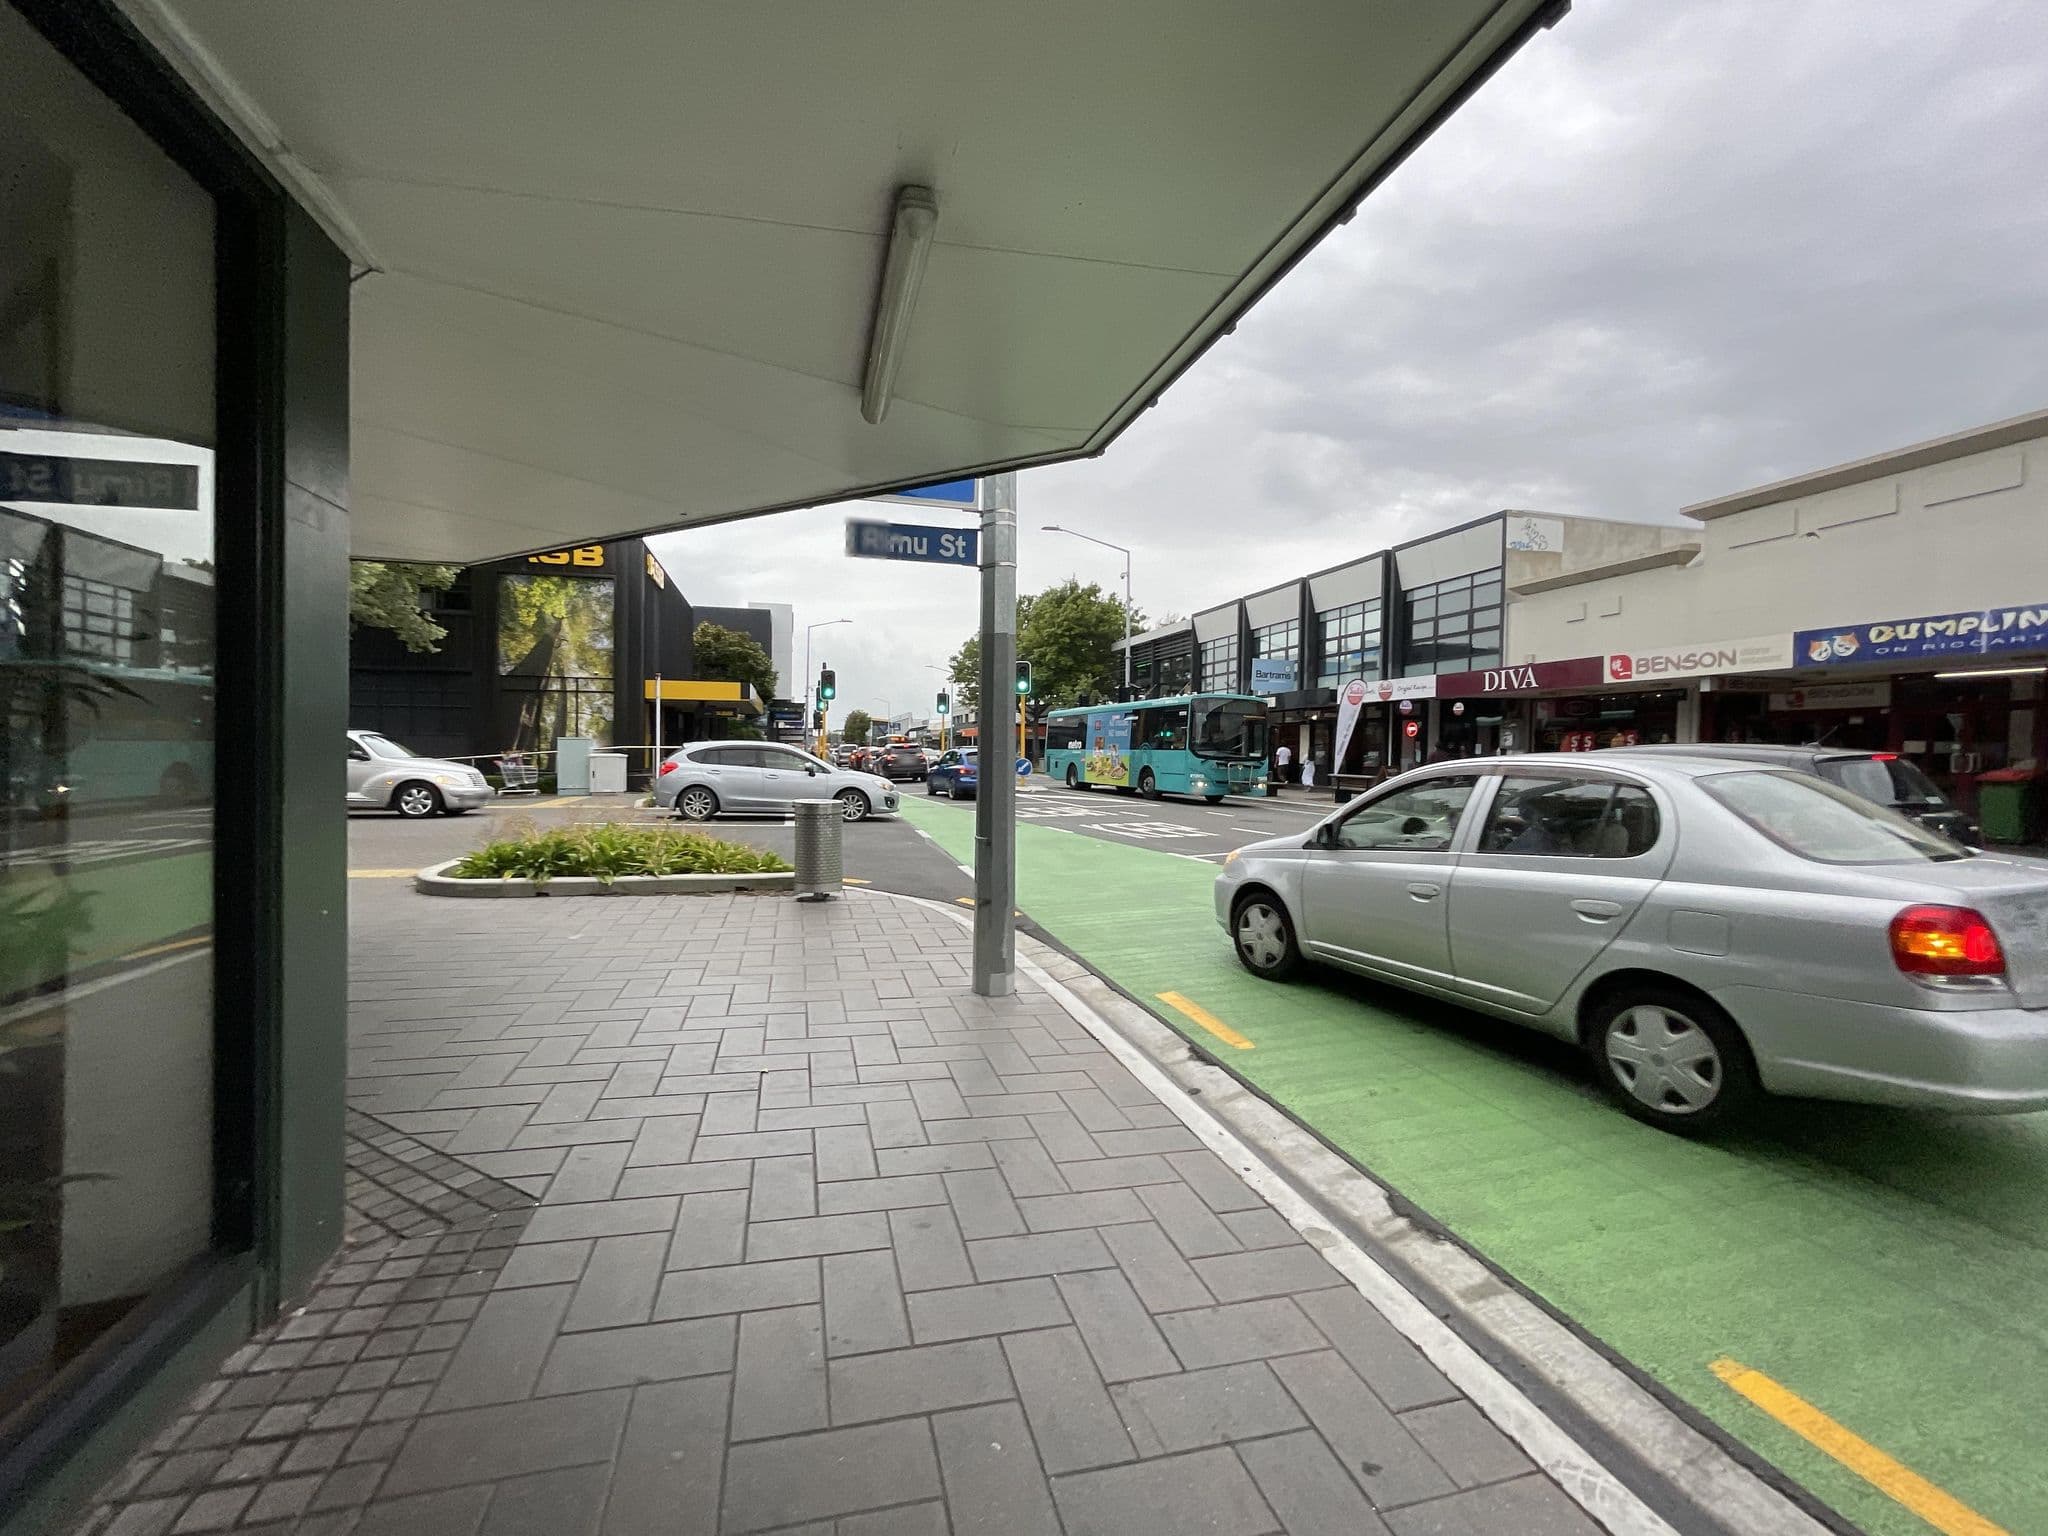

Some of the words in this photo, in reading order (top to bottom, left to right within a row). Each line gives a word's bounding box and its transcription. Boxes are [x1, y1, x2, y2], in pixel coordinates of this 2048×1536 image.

[938, 533, 967, 559] St
[1635, 649, 1738, 675] BENSON
[1875, 645, 1907, 655] ON
[1255, 668, 1292, 682] Bartrams
[1483, 666, 1540, 692] DIVA
